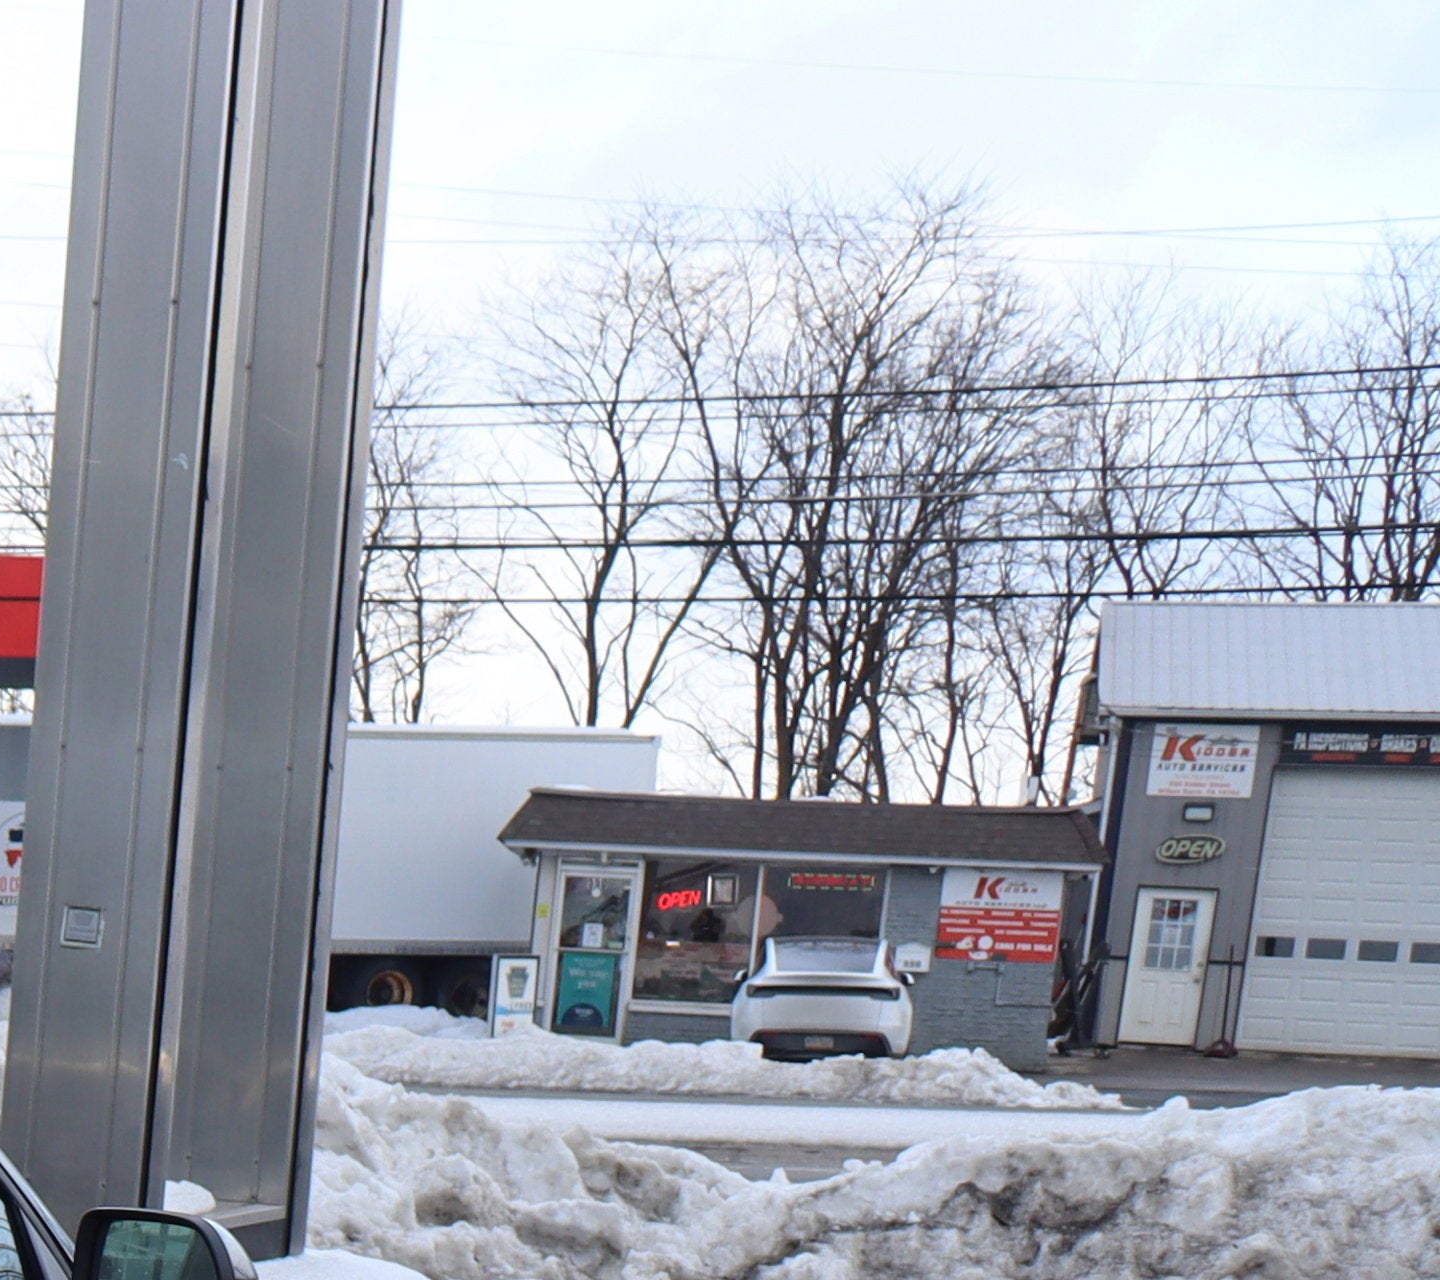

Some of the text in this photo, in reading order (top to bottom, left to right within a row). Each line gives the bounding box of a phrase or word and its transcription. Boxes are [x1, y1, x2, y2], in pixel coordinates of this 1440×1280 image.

[1161, 733, 1251, 762] KIDDER
[1156, 763, 1246, 773] AUTO SERVICES
[1161, 839, 1218, 858] OPEN
[656, 889, 702, 911] OPEN
